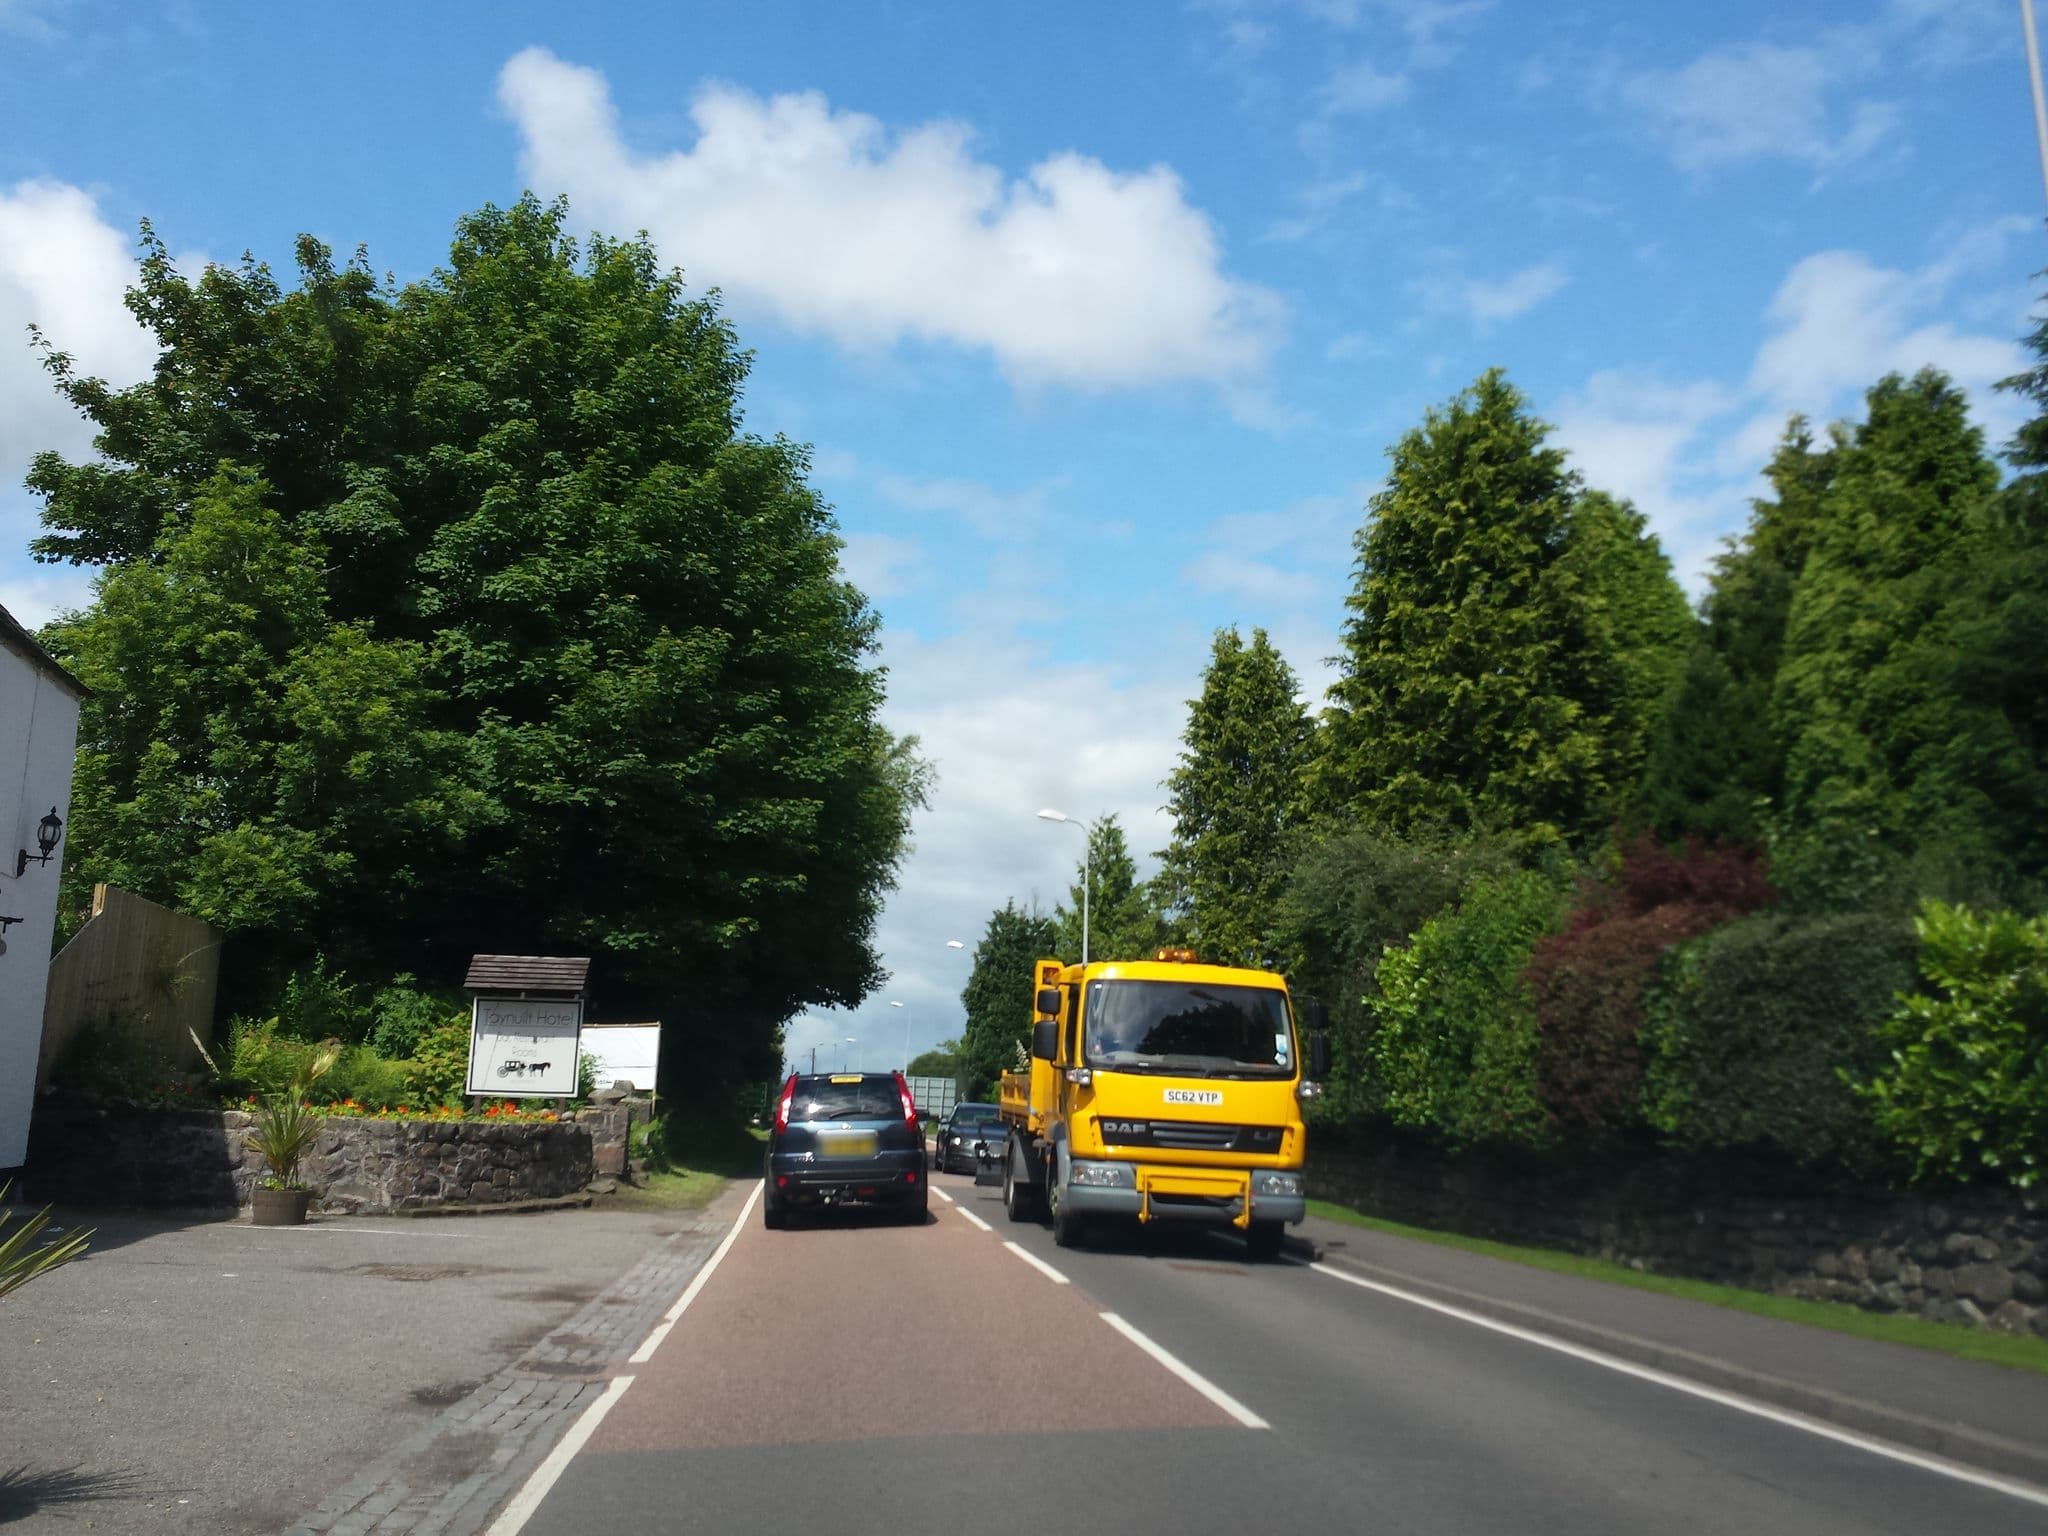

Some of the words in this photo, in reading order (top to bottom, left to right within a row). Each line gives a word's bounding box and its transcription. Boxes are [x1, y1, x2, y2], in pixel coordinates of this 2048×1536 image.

[536, 1007, 575, 1026] Hotel
[1168, 1090, 1196, 1103] SC62
[1103, 1122, 1146, 1133] DAF
